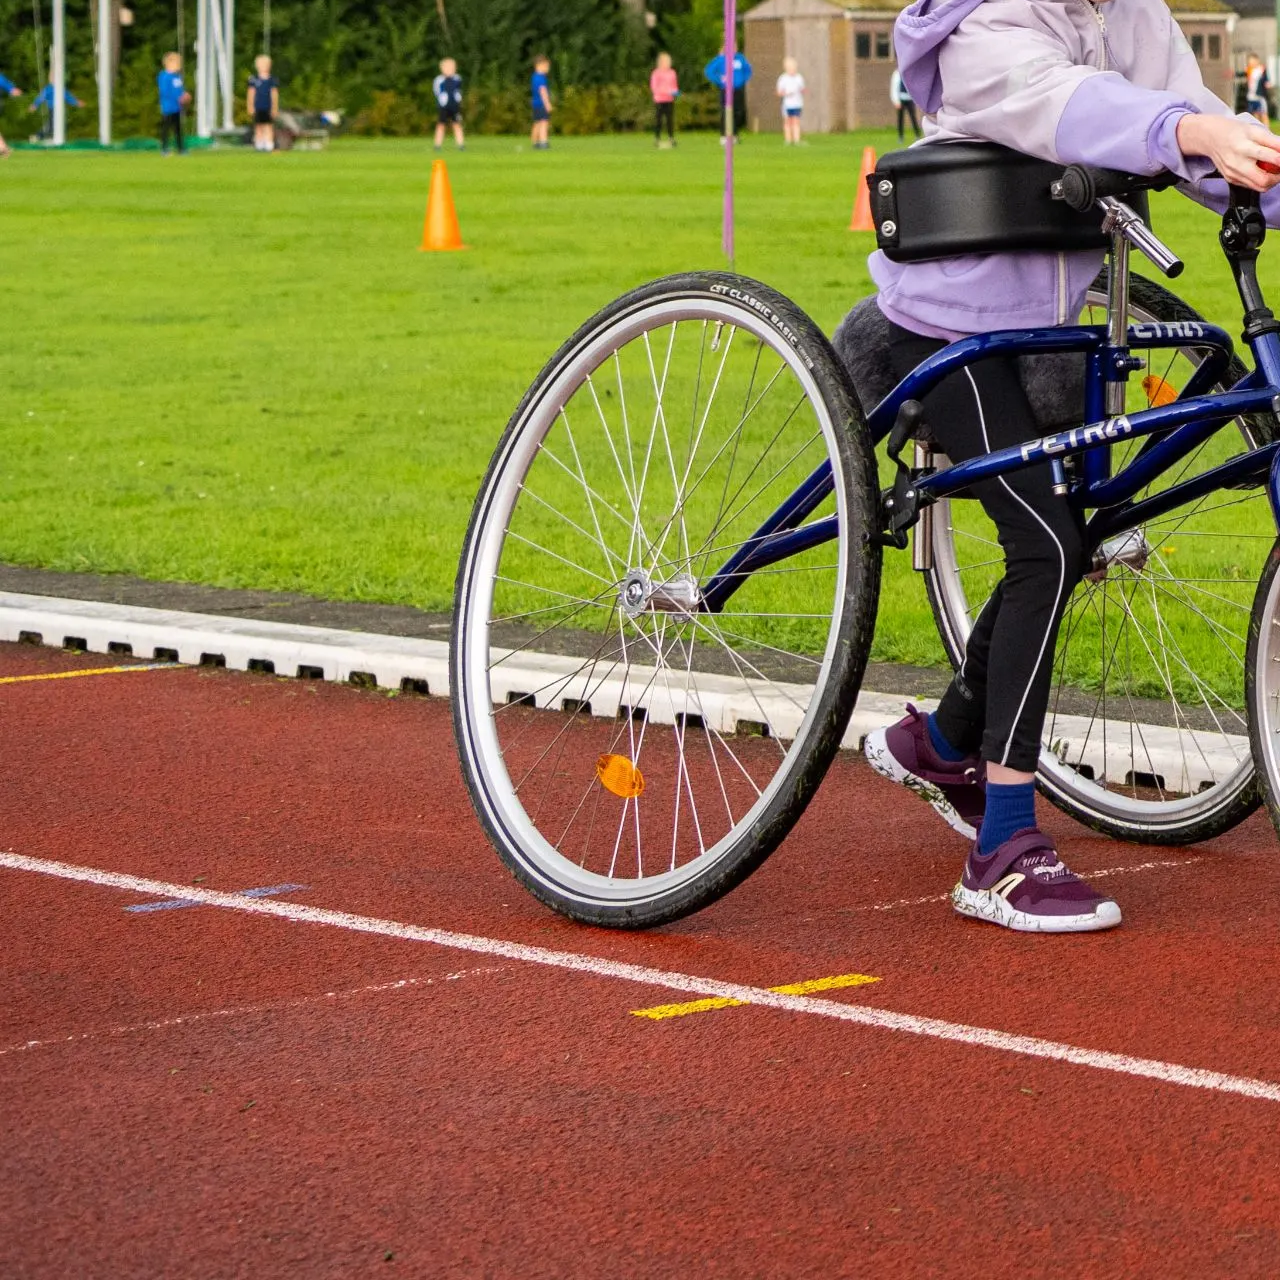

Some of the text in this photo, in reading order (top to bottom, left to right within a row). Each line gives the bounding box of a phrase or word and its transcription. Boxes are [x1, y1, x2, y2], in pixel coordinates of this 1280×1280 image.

[710, 284, 798, 345] CST CLASSIC BASIC
[1127, 321, 1204, 339] ETRA
[1020, 414, 1132, 461] PETRA
